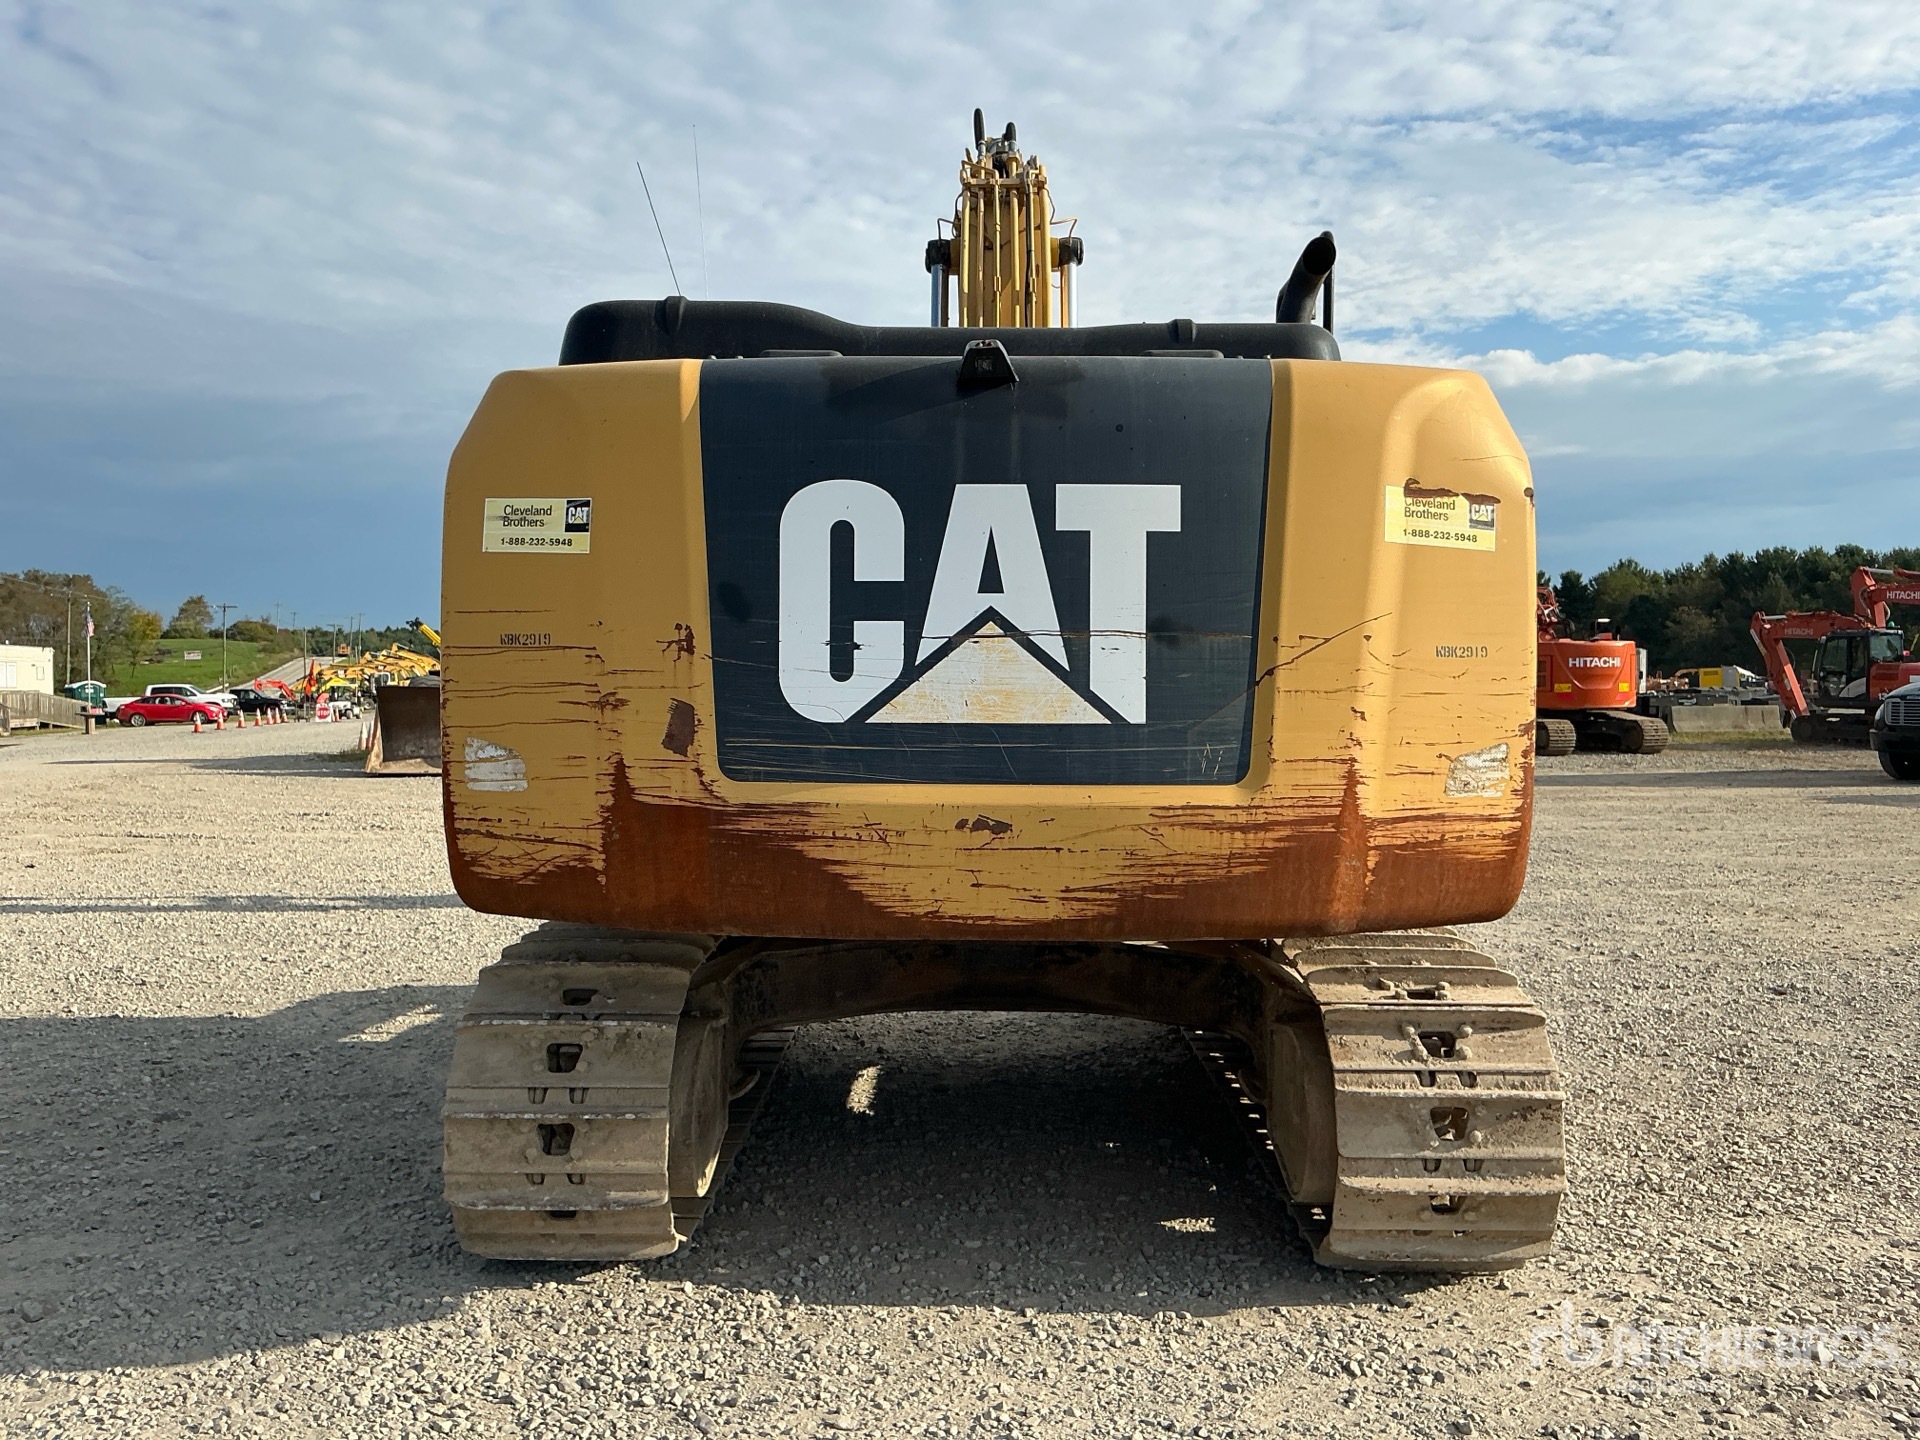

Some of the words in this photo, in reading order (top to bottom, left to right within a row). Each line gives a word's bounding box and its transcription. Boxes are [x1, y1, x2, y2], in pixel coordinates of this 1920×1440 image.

[503, 505, 553, 516] Cleveland
[1405, 497, 1456, 511] Cleveland
[568, 507, 590, 524] CAT
[1404, 507, 1449, 522] Brothers
[1471, 504, 1494, 522] CAT
[502, 516, 545, 527] Brothers
[500, 537, 573, 547] 1-888-232-5948
[1403, 528, 1478, 543] 1-888-232-5948
[779, 479, 1182, 725] CAT
[1886, 590, 1920, 600] HITACHI
[1568, 656, 1621, 668] HITACHI
